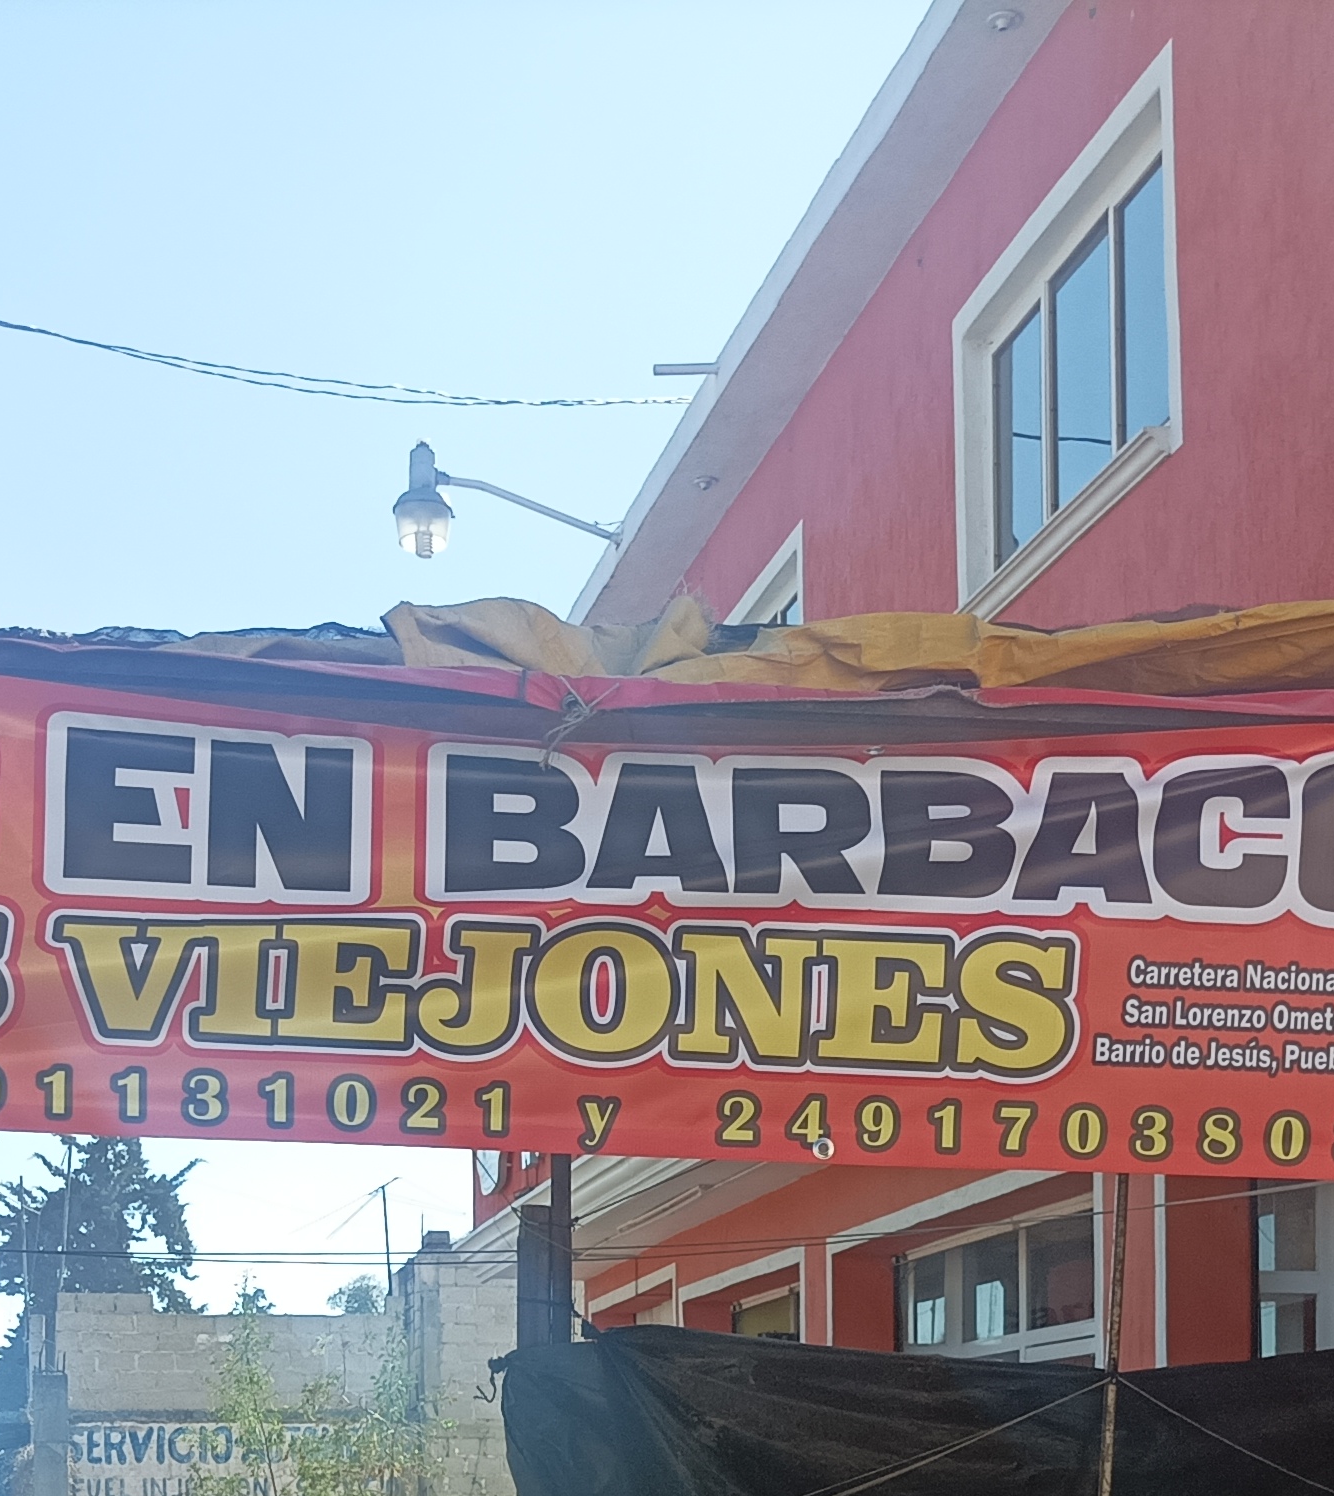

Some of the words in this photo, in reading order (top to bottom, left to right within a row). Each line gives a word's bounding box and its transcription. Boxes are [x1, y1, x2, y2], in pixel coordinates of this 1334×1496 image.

[51, 716, 365, 902] EN
[53, 912, 1076, 1076] VIEJONES
[1129, 958, 1240, 989] Carretera
[1123, 998, 1168, 1026] San
[1173, 1000, 1266, 1029] Lorenzo
[1094, 1036, 1166, 1065] Barrio
[1171, 1039, 1201, 1067] de
[1205, 1041, 1279, 1076] Jesús,
[578, 1094, 617, 1147] y
[67, 1425, 233, 1466] SERVICIO
